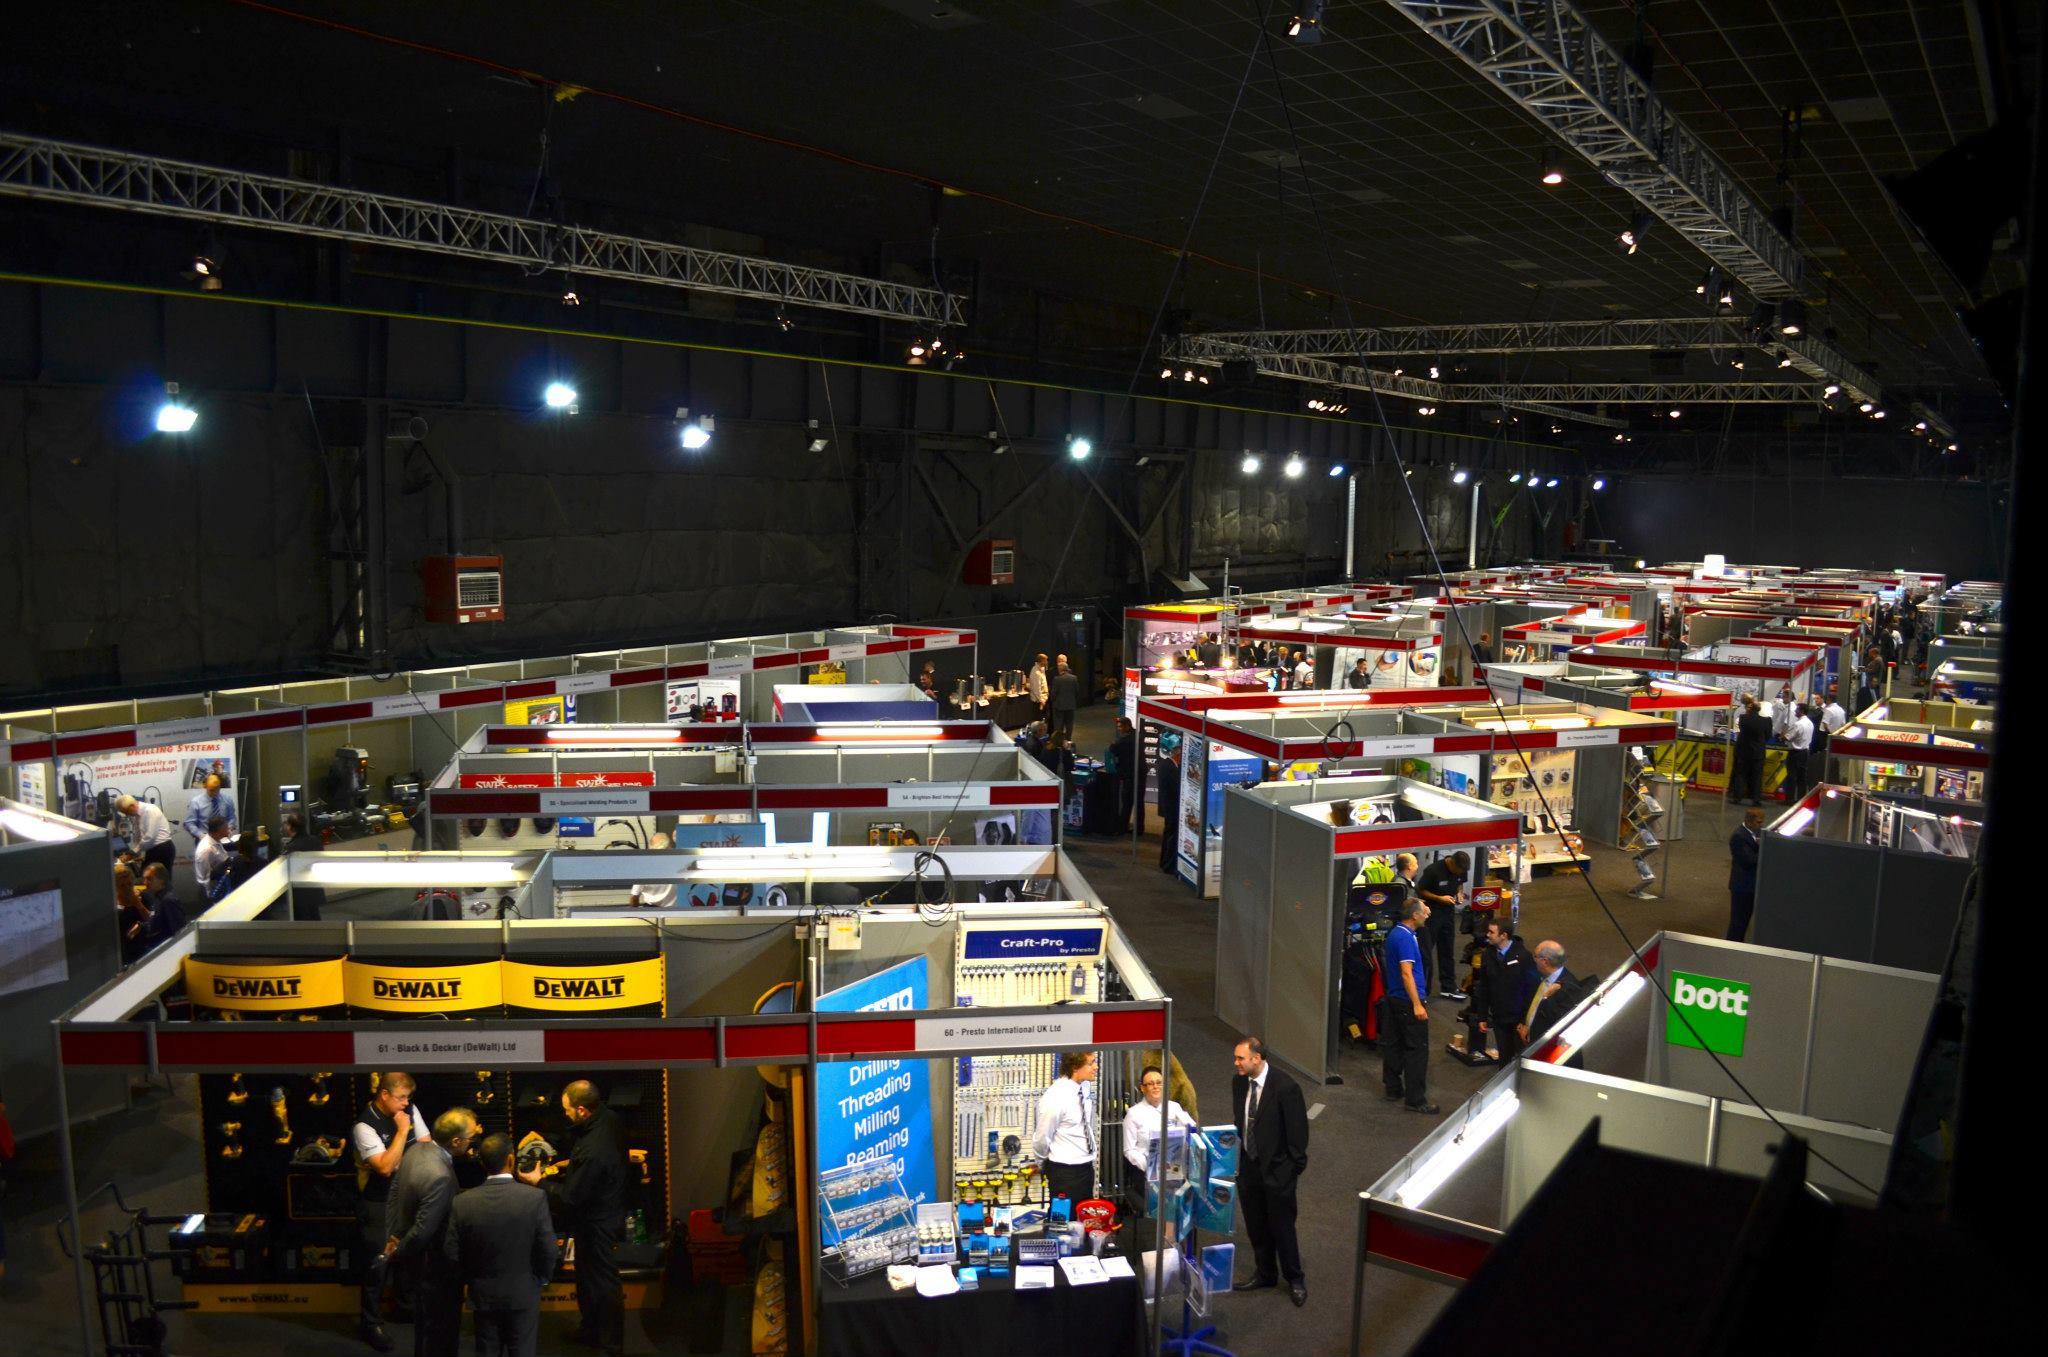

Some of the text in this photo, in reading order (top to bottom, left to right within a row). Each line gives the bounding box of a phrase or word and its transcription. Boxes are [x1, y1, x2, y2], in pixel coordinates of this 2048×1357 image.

[177, 744, 220, 753] SYSTEMS
[96, 763, 122, 773] Increase
[124, 761, 167, 770] productivity
[96, 771, 110, 780] site
[127, 768, 139, 776] the
[140, 765, 178, 775] workshop!
[1000, 938, 1064, 948] Craft-Pro
[1674, 978, 1749, 1016] bott
[944, 1028, 954, 1037] 60
[961, 1028, 986, 1036] Presto
[987, 1025, 1035, 1035] International
[1037, 1024, 1048, 1033] UK
[1049, 1024, 1062, 1032] Ltd
[378, 1044, 389, 1053] 61
[397, 1043, 420, 1053] Black
[422, 1043, 430, 1052] &
[432, 1043, 461, 1052] Decker
[463, 1042, 501, 1053] (DeWalt)
[503, 1042, 517, 1051] Ltd
[849, 1059, 900, 1087] Drilling
[838, 1071, 911, 1119] Threading
[854, 1103, 900, 1141] Milling
[846, 1126, 909, 1167] Reaming
